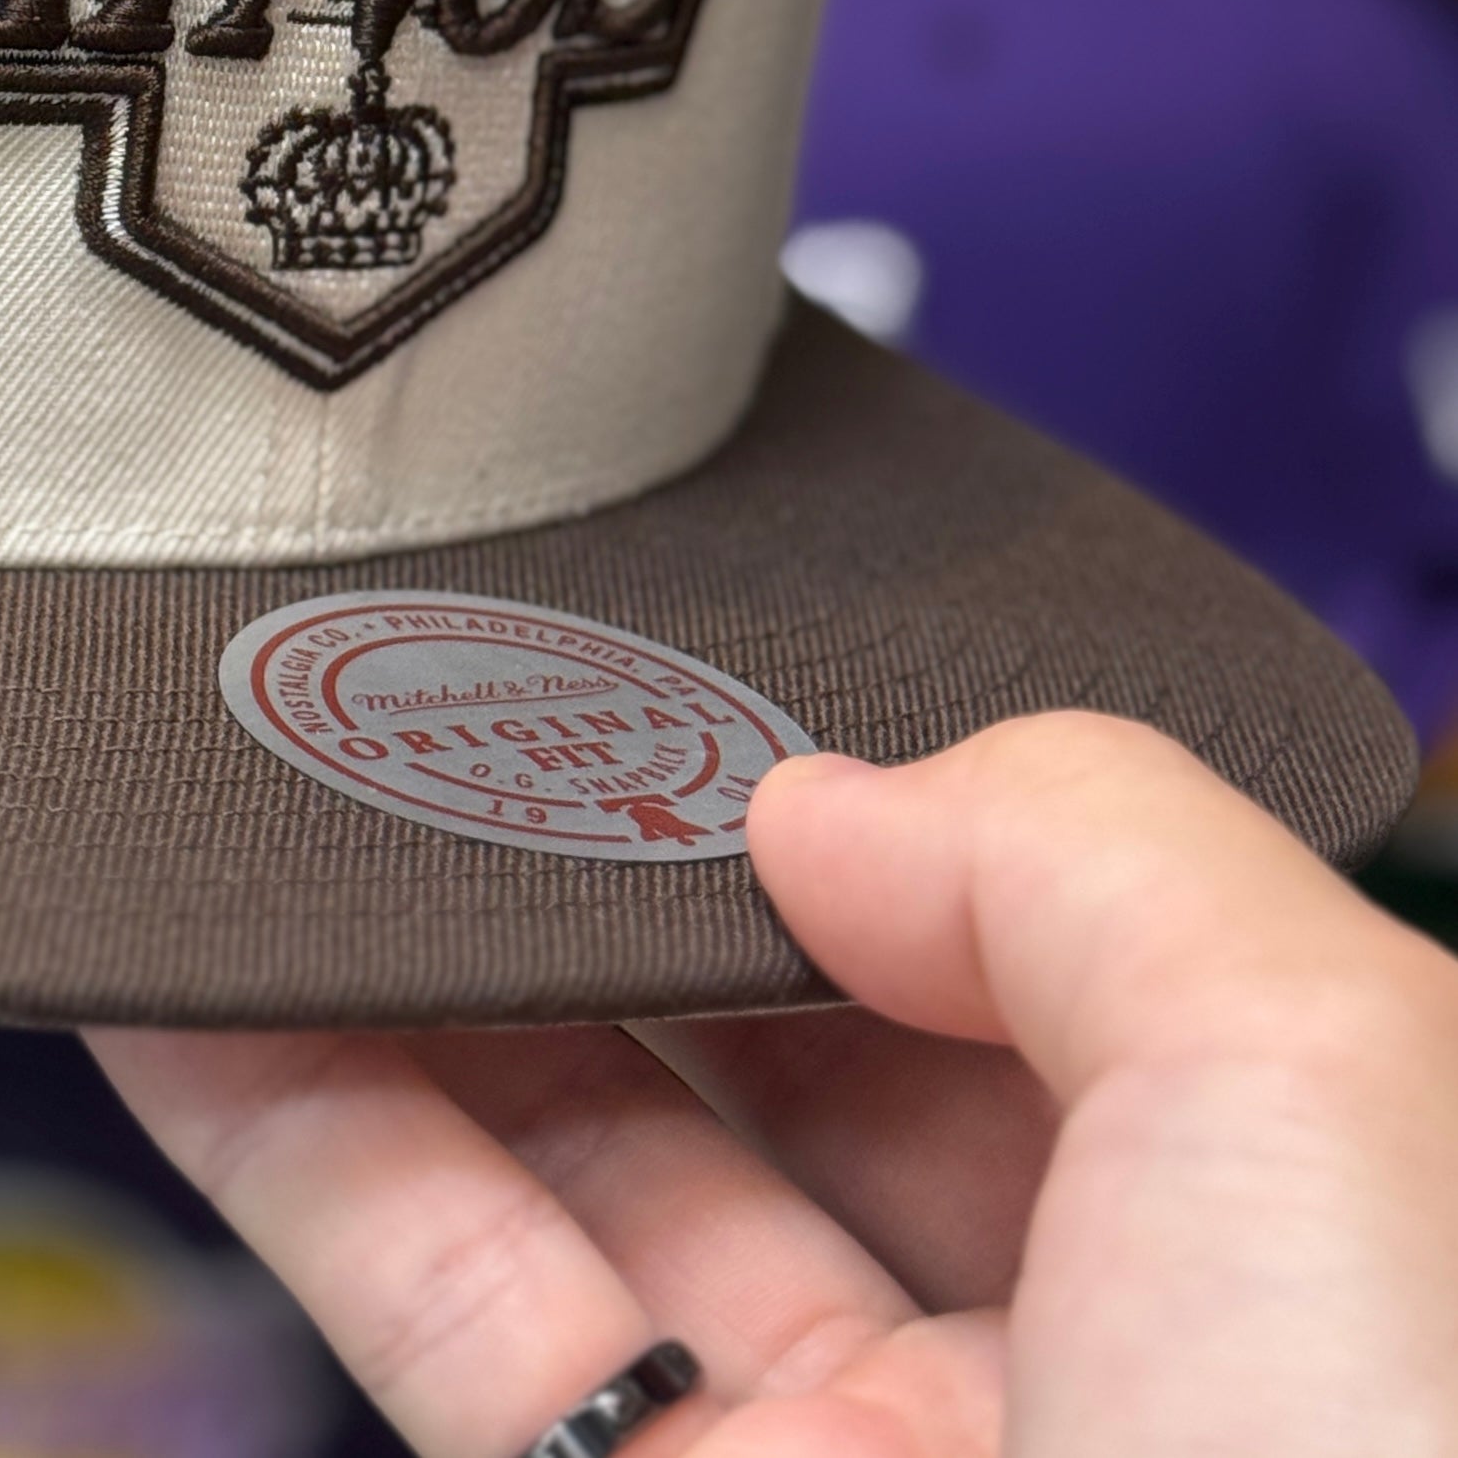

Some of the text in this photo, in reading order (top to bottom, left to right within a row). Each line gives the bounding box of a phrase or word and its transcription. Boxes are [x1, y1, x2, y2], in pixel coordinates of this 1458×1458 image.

[276, 647, 335, 736] NOSTALGIA
[351, 673, 620, 712] Mitchell & Ness
[338, 702, 736, 761] ORIGINAL
[518, 741, 624, 773] FIT
[567, 742, 688, 795] SNAPBACK
[487, 798, 548, 825] 19
